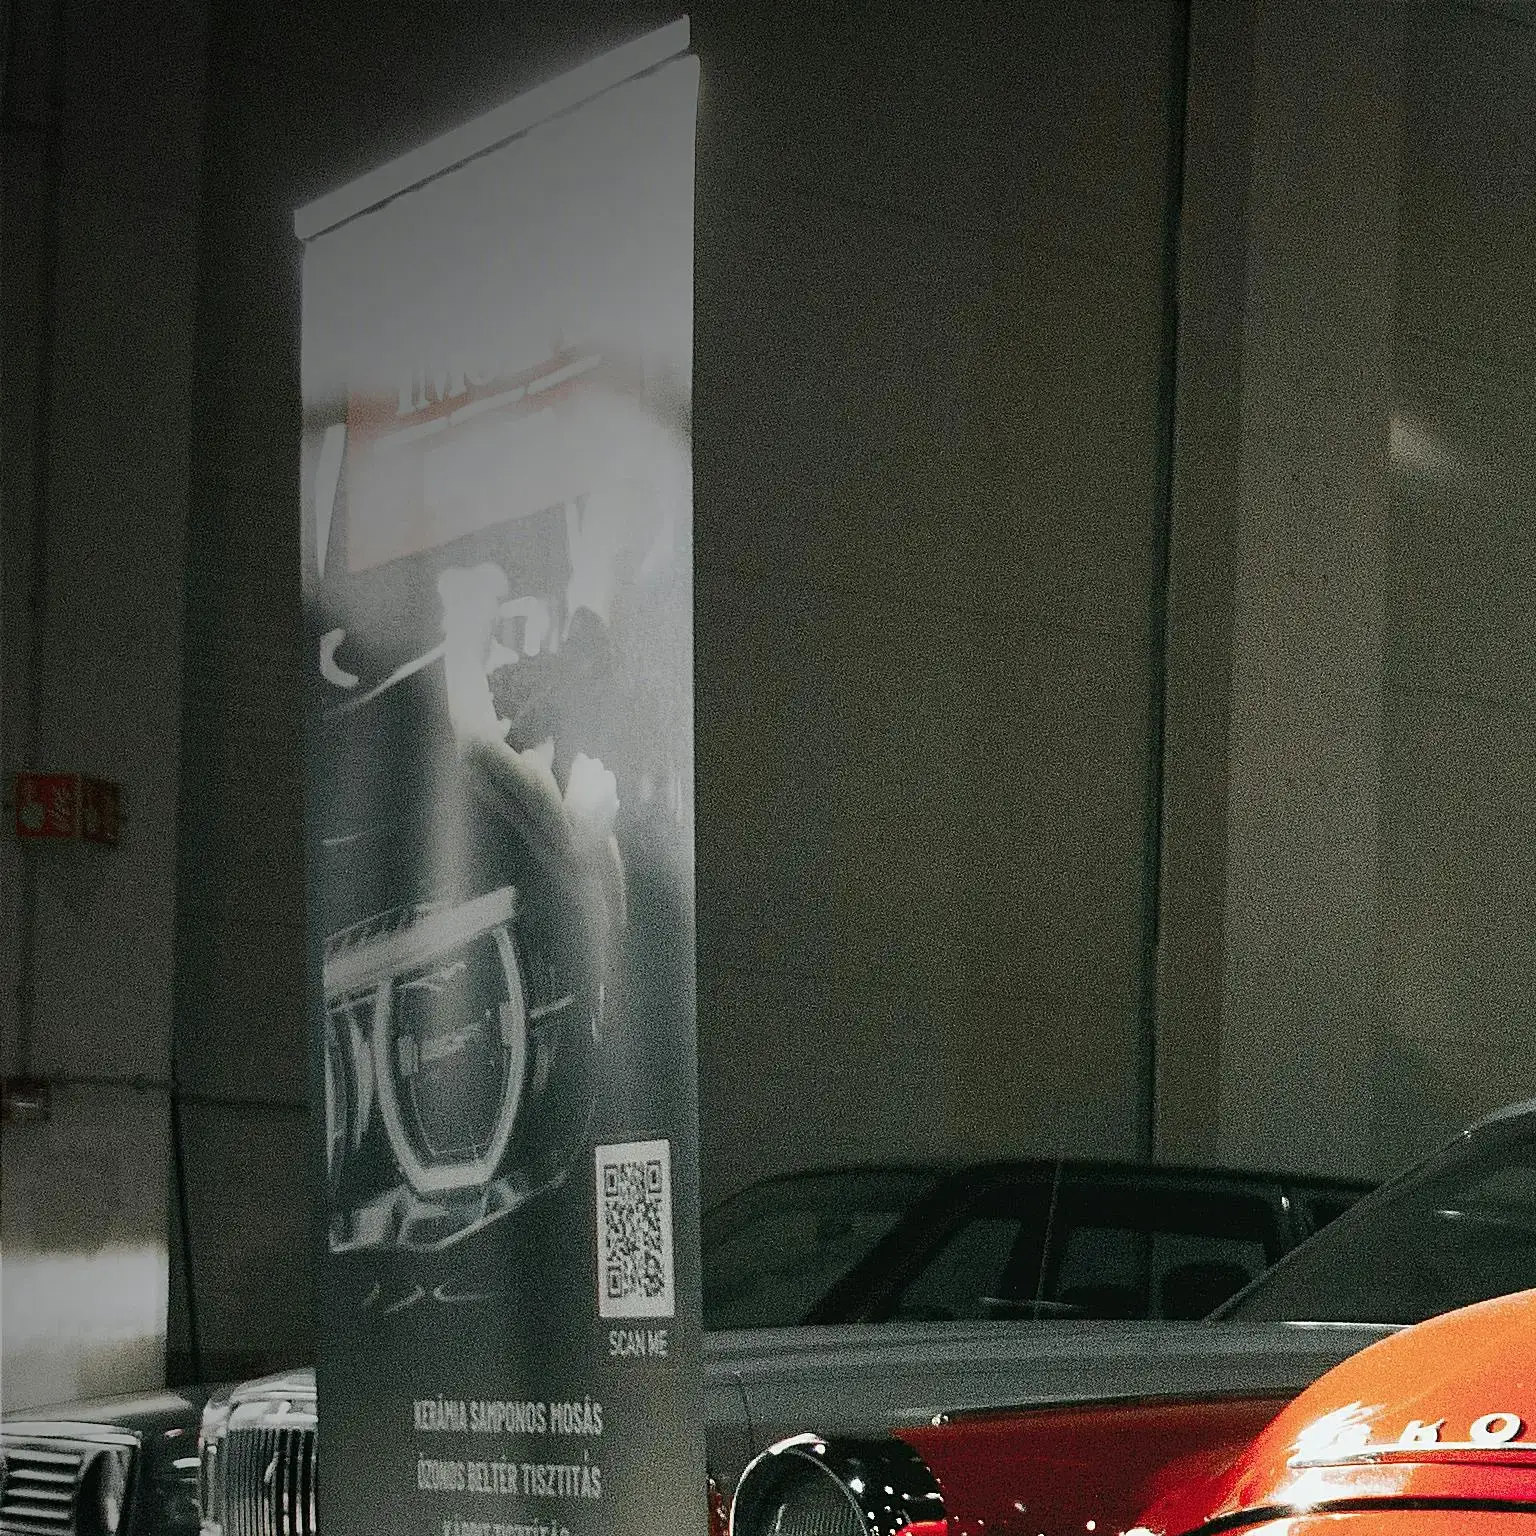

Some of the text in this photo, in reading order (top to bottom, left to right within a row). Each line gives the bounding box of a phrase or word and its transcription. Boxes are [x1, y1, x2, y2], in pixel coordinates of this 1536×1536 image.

[608, 1330, 668, 1356] SCAN ME
[413, 1393, 602, 1435] KERÁMIA SAMPONOS MOSÁS
[467, 1453, 518, 1494] BELTÉR
